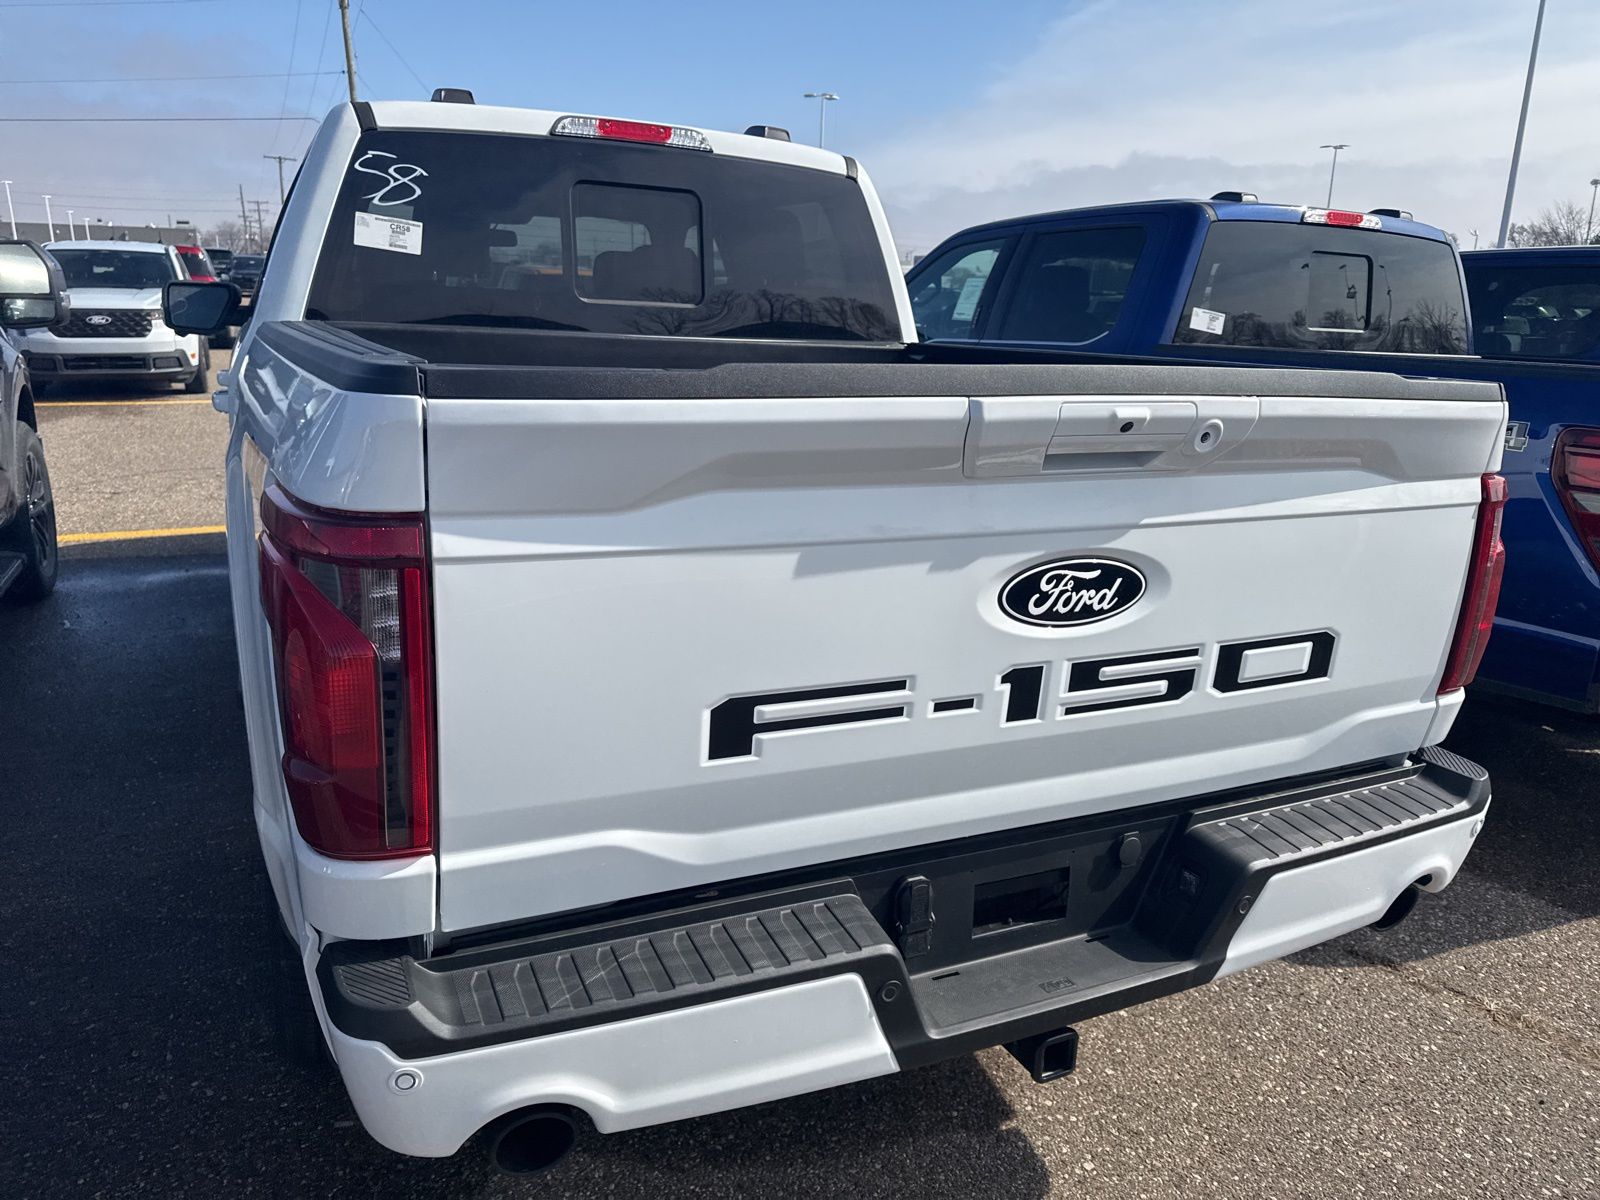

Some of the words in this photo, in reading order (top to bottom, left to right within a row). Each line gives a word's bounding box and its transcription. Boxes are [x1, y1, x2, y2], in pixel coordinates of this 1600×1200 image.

[354, 150, 429, 206] 58
[1028, 569, 1123, 616] Ford
[703, 629, 1337, 764] F-150
